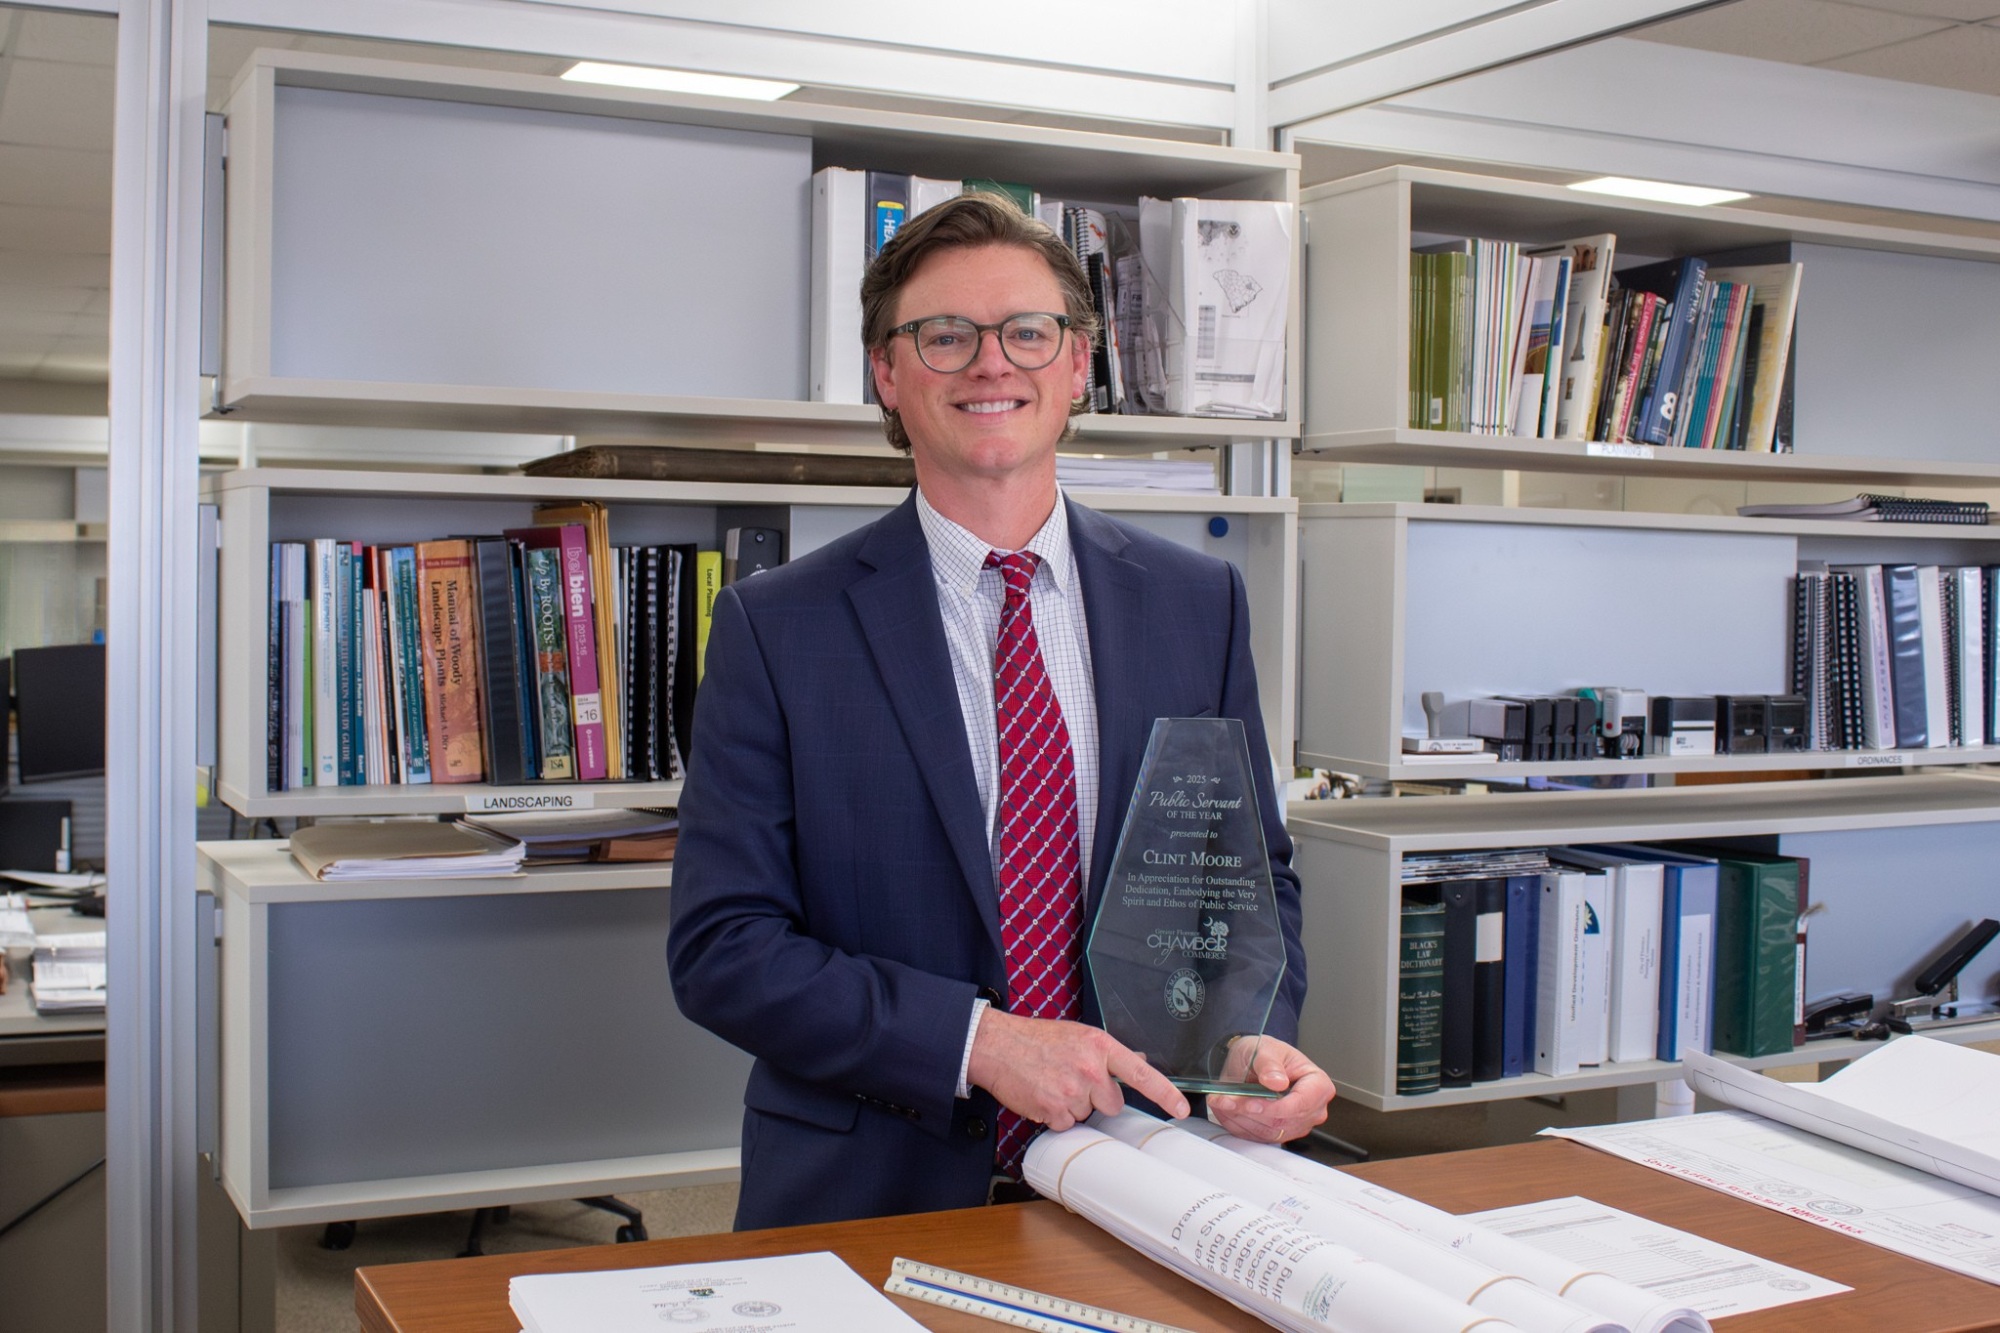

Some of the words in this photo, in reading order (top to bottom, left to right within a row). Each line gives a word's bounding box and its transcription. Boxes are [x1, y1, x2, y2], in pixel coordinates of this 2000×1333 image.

[1660, 392, 1677, 420] 8
[536, 559, 550, 575] Up
[537, 578, 552, 592] By
[446, 580, 458, 626] Manual
[705, 588, 713, 617] Planning
[430, 580, 444, 645] Landscape
[541, 595, 554, 644] ROOTS:
[449, 628, 460, 641] of
[435, 648, 446, 687] Plants
[449, 643, 463, 686] Woody
[342, 700, 351, 731] STUDY
[438, 693, 447, 723] Michael
[342, 733, 351, 763] GUIDE
[1857, 755, 1902, 765] ORDINANCES
[1186, 775, 1207, 784] 2025
[484, 796, 573, 809] LANDSCAPING
[1149, 790, 1190, 808] Public
[1192, 792, 1243, 809] Servant
[1166, 810, 1178, 819] OF
[1180, 810, 1197, 820] THE
[1198, 811, 1223, 820] YEAR
[1170, 830, 1209, 839] presented
[1210, 831, 1218, 839] to
[1142, 849, 1187, 865] CLINT
[1190, 851, 1242, 868] MOORE
[1127, 873, 1136, 882] In
[1138, 873, 1190, 884] Appreciation
[1191, 875, 1203, 884] for
[1205, 875, 1256, 889] Outstanding
[1125, 884, 1171, 896] Dedication,
[1173, 886, 1220, 899] Embodying
[1222, 888, 1235, 898] the
[1237, 889, 1257, 901] Very
[1122, 896, 1146, 907] Spirit
[1146, 898, 1161, 906] and
[1163, 898, 1187, 908] Ethos
[1188, 899, 1199, 908] of
[1199, 900, 1225, 910] Public
[1227, 901, 1258, 911] Service
[1182, 950, 1227, 960] COMMERCE
[1417, 949, 1431, 959] LAW
[1400, 957, 1443, 969] DICTIONARY
[1571, 943, 1579, 993] Development
[1168, 970, 1196, 986] MARION
[1644, 1158, 1677, 1170] SOUTH
